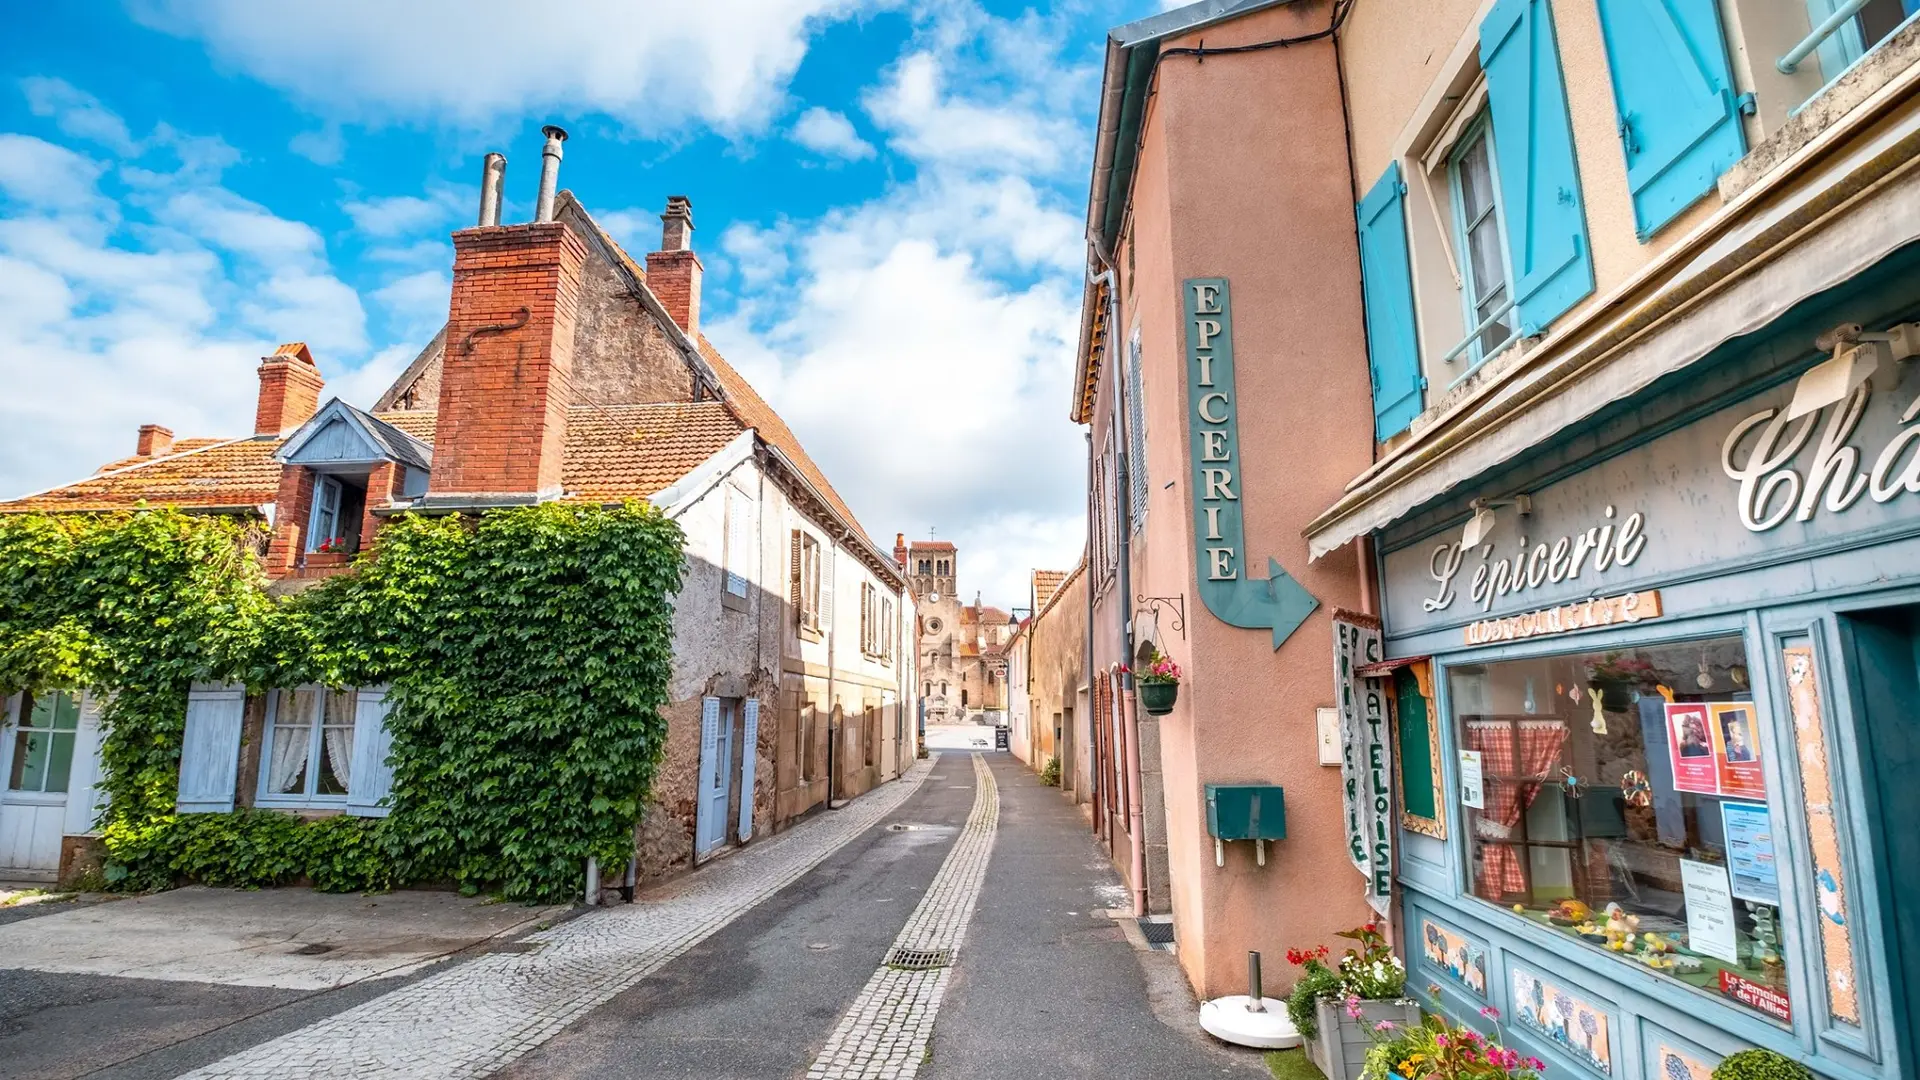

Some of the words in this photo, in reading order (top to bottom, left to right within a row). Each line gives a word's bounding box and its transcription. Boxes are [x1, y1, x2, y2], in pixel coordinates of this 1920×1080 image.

[1193, 284, 1238, 581] EPICERIE
[1423, 504, 1648, 613] Lépicerie
[1724, 971, 1738, 985] La
[1738, 978, 1789, 1008] Semaine
[1736, 988, 1752, 1003] de
[1751, 994, 1789, 1019] l'Allier
